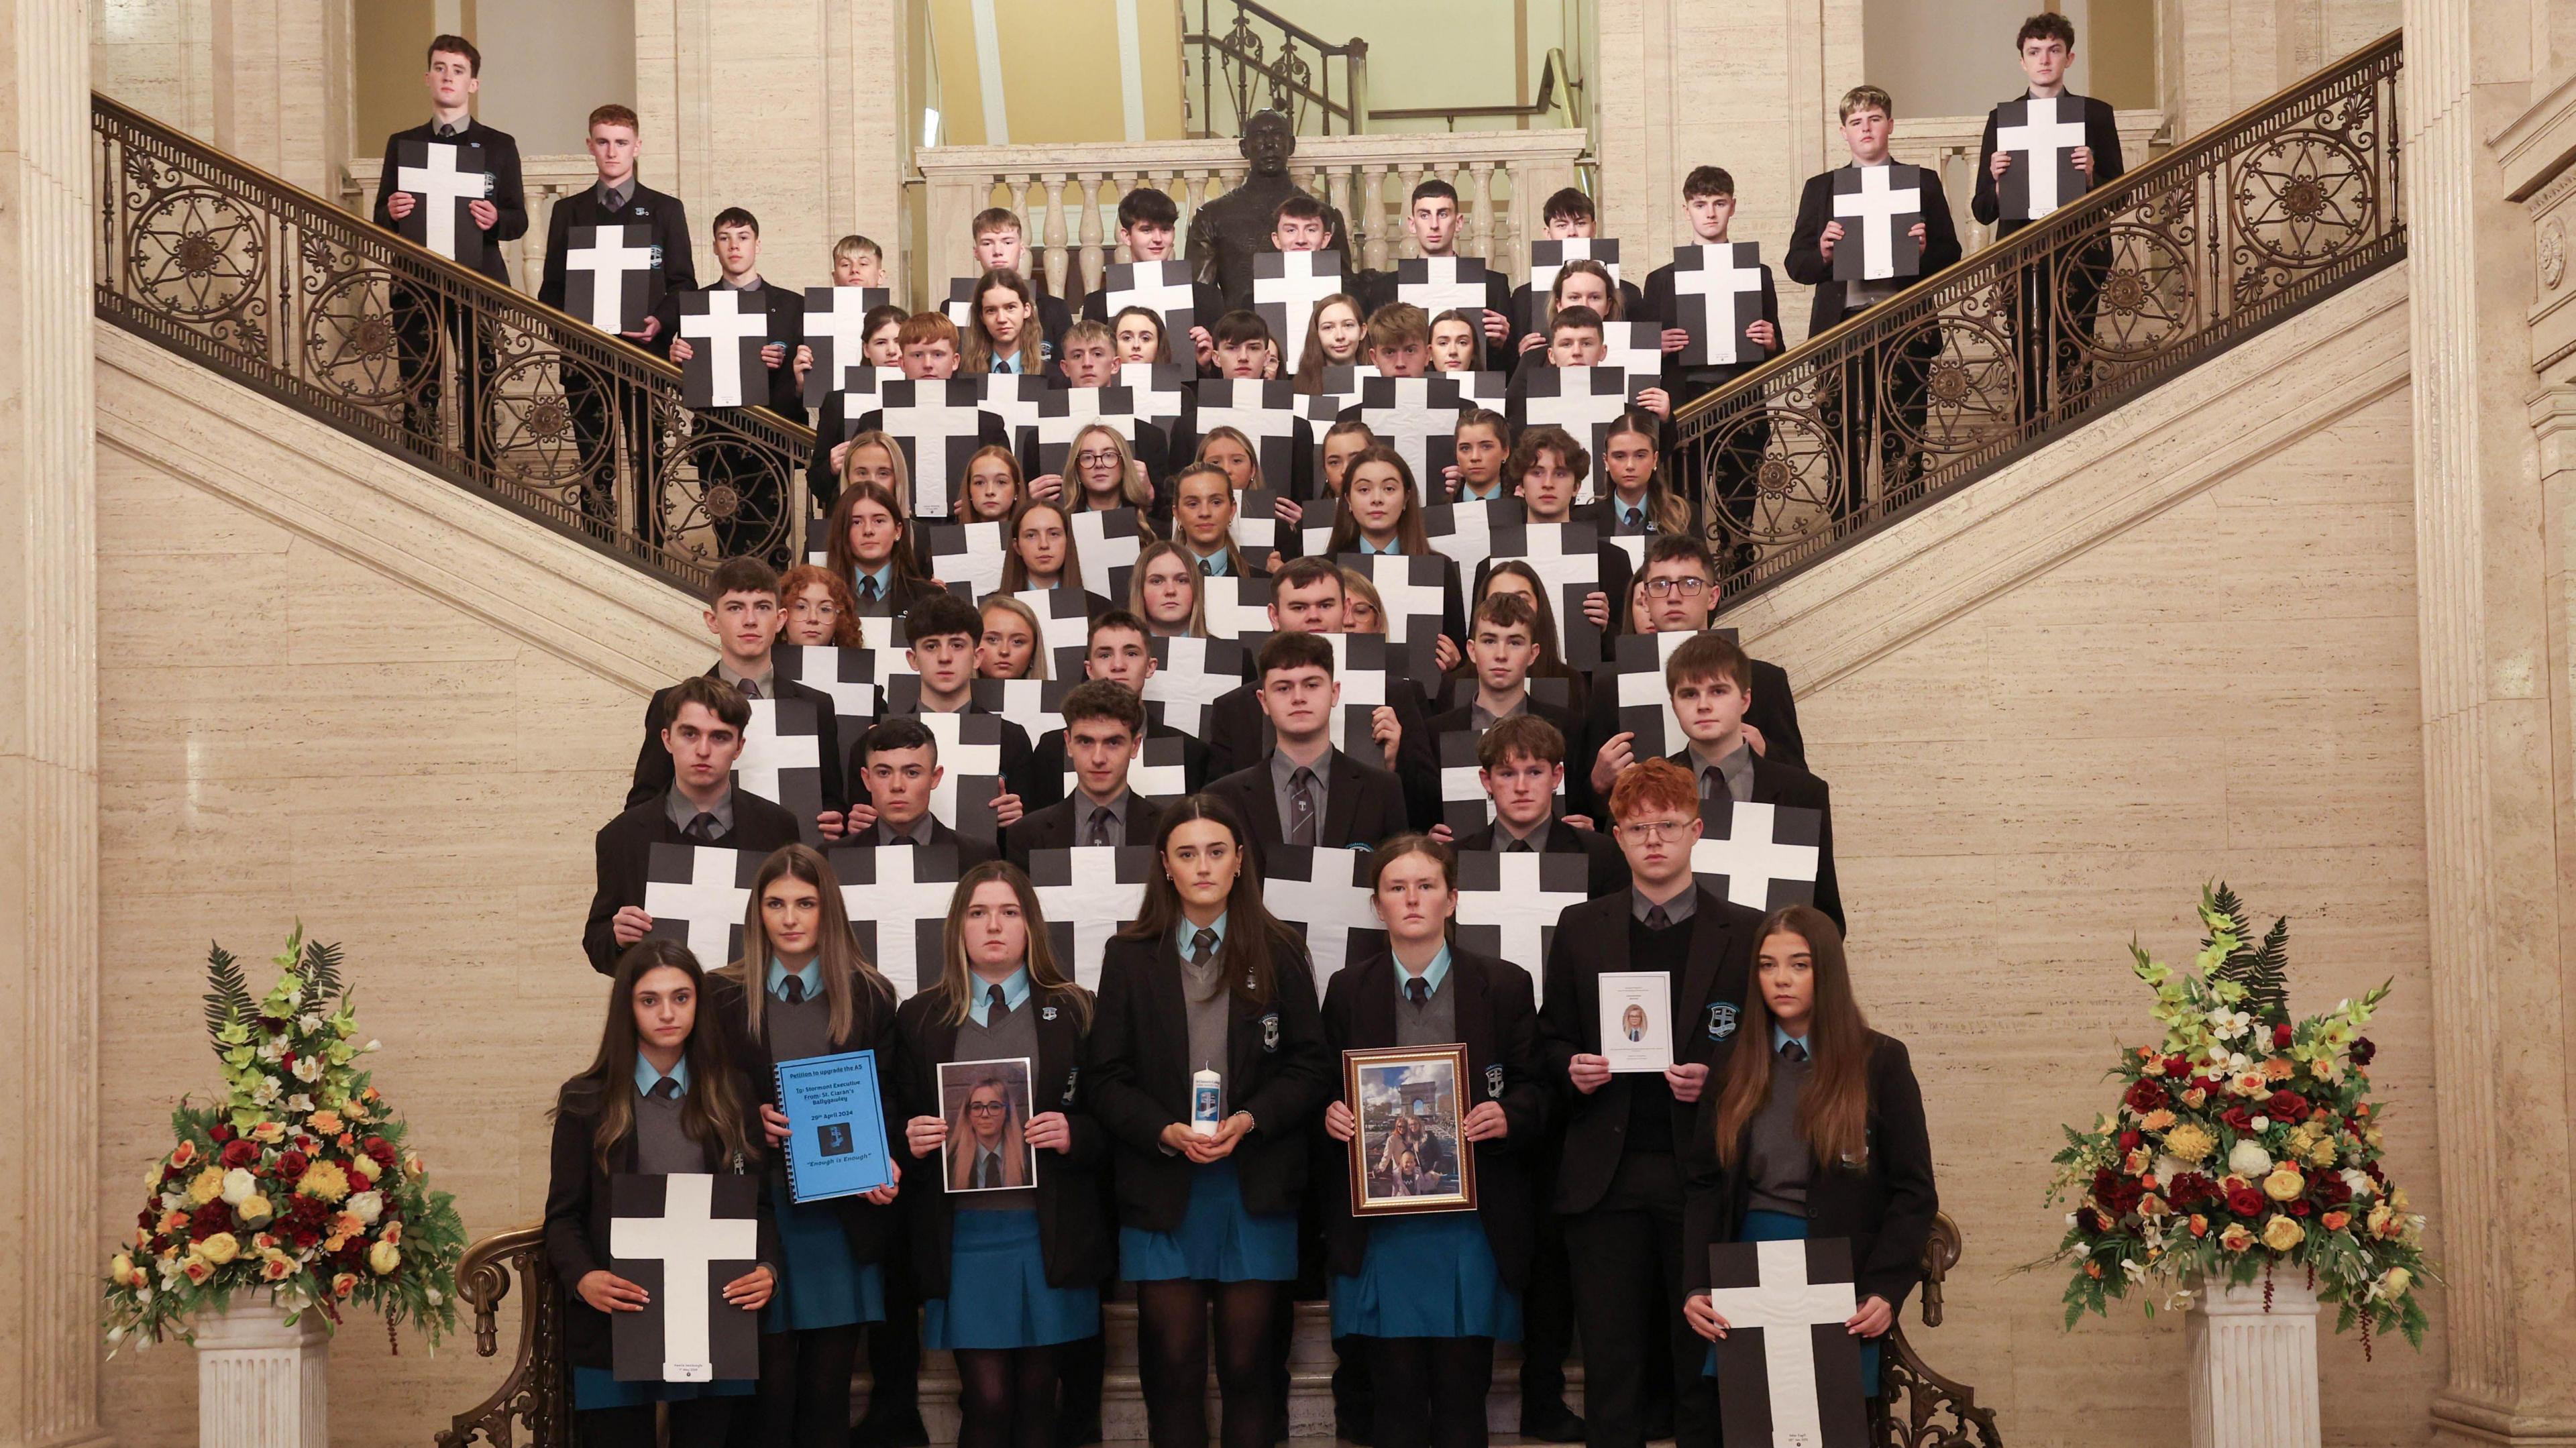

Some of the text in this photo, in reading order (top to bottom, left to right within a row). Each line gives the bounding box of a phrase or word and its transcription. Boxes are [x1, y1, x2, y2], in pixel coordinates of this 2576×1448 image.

[790, 1071, 812, 1079] Petition
[820, 1066, 843, 1076] upgrade
[805, 1084, 832, 1093] Stormont
[833, 1080, 861, 1089] Executive
[824, 1111, 838, 1119] April
